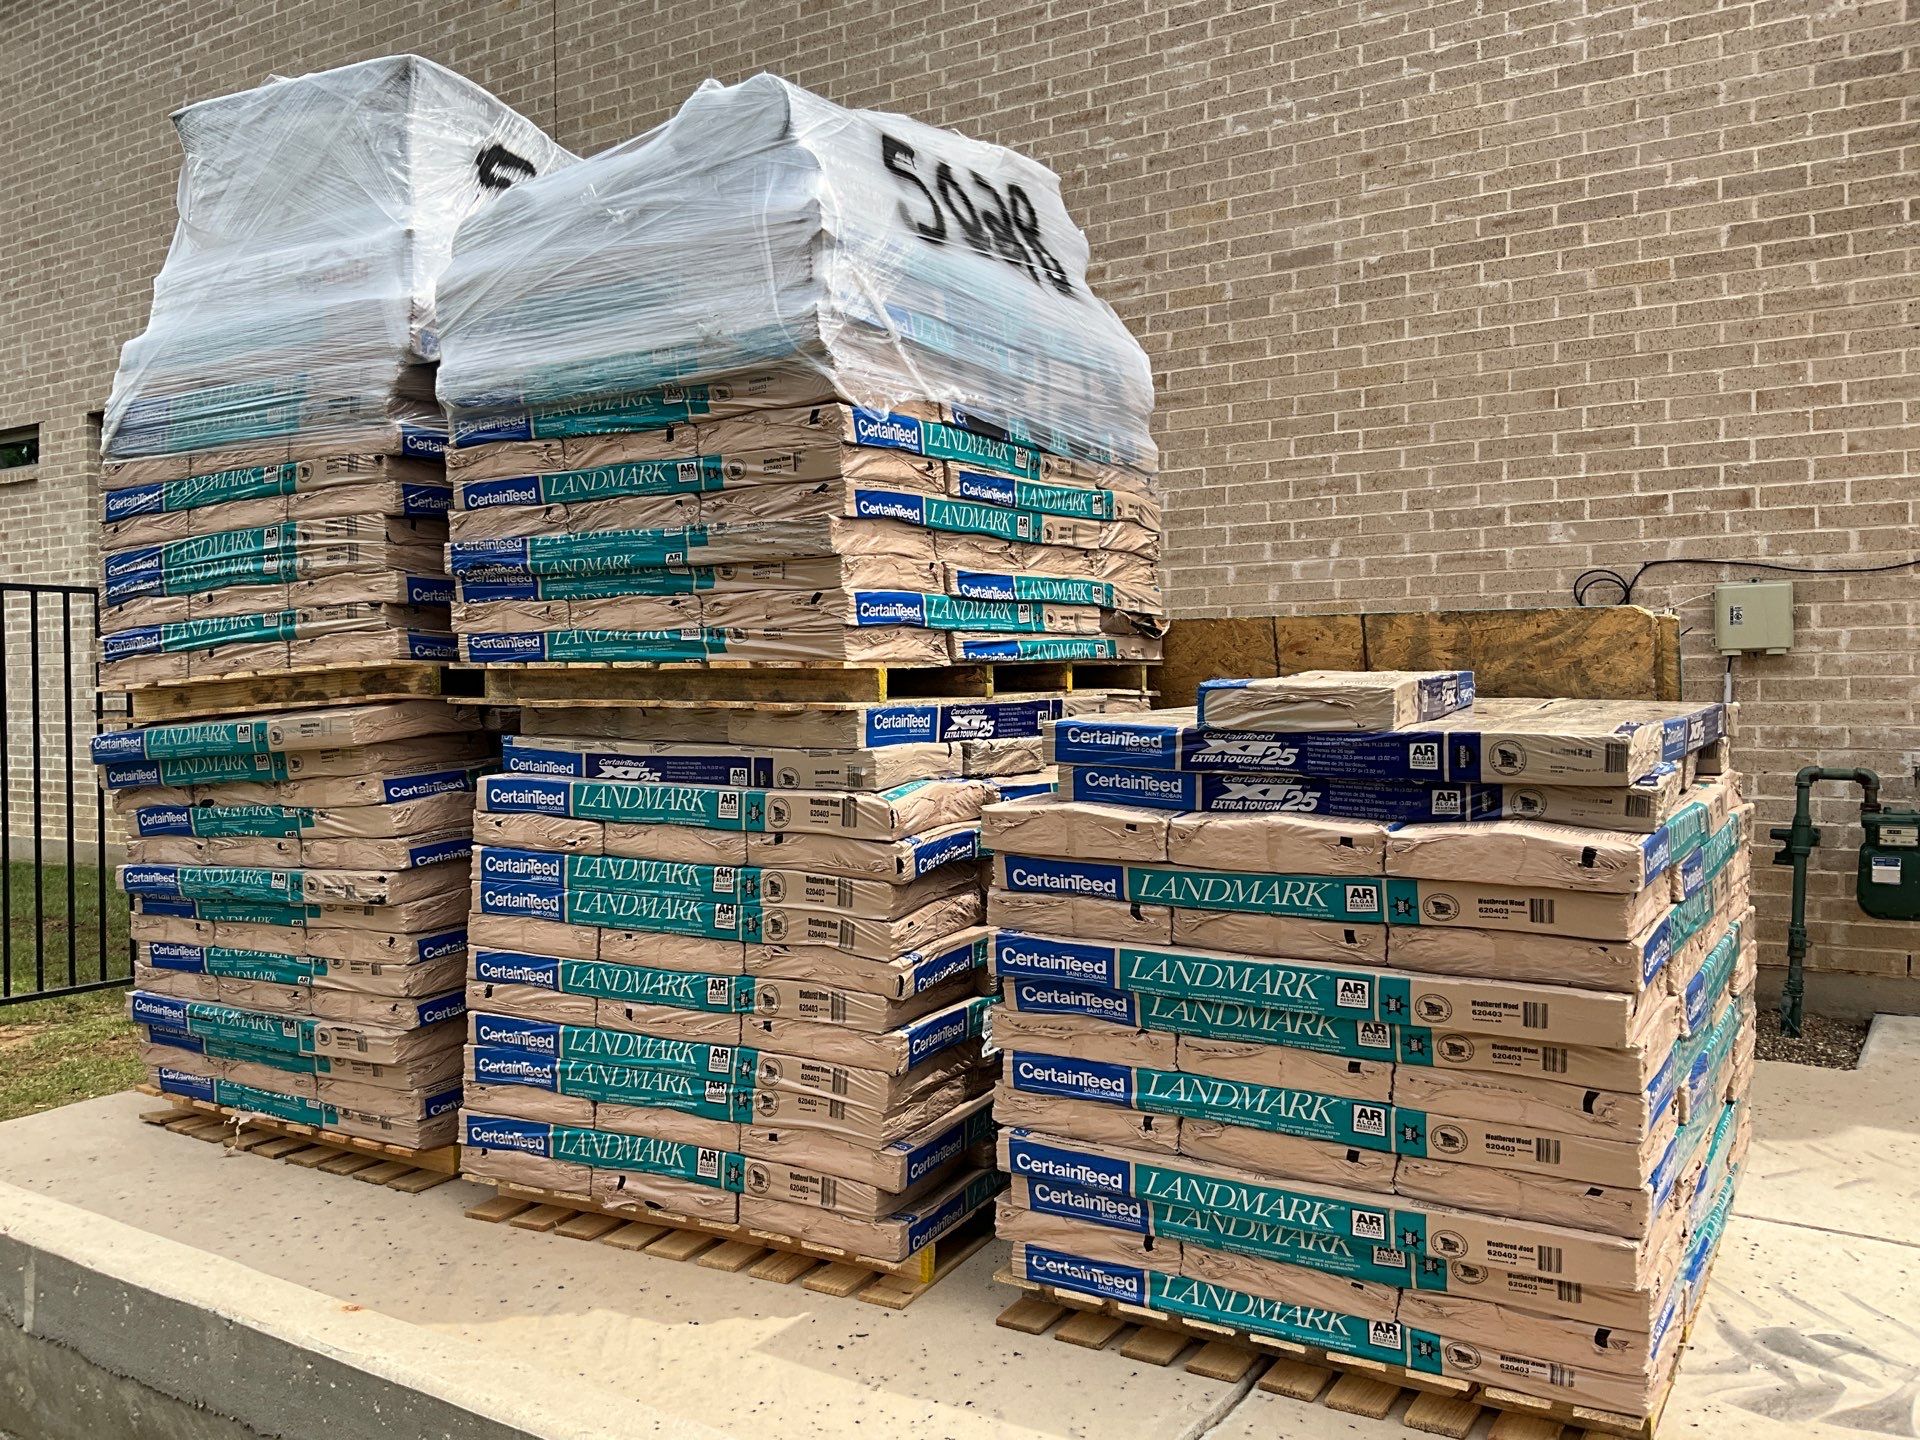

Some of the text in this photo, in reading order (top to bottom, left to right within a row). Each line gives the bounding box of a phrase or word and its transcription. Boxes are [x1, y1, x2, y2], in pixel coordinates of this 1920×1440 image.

[459, 415, 526, 434] CertainTeed
[858, 419, 918, 444] CertainTeed
[928, 423, 1009, 461] LANDMARK
[680, 463, 695, 473] AR
[170, 467, 256, 498] LANDMARK
[550, 462, 668, 496] LANDMARK
[468, 487, 536, 507] CertainTeed
[962, 482, 1013, 504] CertainTeed
[1021, 486, 1089, 511] LANDMARK
[860, 501, 920, 521] CertainTeed
[930, 503, 1013, 532] LANDMARK
[168, 528, 257, 563] LANDMARK
[539, 554, 634, 575] LANDMARK
[962, 584, 1013, 600] CertainTeed
[1021, 581, 1090, 601] LANDMARK
[860, 602, 921, 618] CertainTeed
[931, 600, 1013, 621] LANDMARK
[168, 616, 255, 641] LANDMARK
[106, 634, 159, 653] CertainTeed
[471, 636, 540, 648] CertainTeed
[951, 708, 985, 716] CertainTeed
[238, 725, 249, 733] AR
[874, 714, 930, 729] CertainTeed
[977, 720, 995, 737] 25
[94, 736, 141, 750] CertainTeed
[151, 724, 231, 746] LANDMARK
[1067, 727, 1163, 749] CertainTeed
[1203, 732, 1275, 741] CertainTeed
[1260, 748, 1299, 766] 25
[1413, 745, 1435, 755] AR
[167, 756, 248, 777] LANDMARK
[510, 758, 574, 775] CertainTeed
[599, 758, 645, 767] CertainTeed
[1190, 754, 1261, 764] EXTRA TOUGH
[109, 768, 157, 783] CertainTeed
[732, 769, 746, 777] AR
[1222, 775, 1294, 784] CertainTeed
[390, 780, 464, 798] CertainTeed
[1085, 772, 1182, 793] CertainTeed
[490, 789, 564, 806] CertainTeed
[578, 785, 706, 813] LANDMARK
[721, 794, 737, 804] AR
[1281, 792, 1321, 811] 25
[1436, 792, 1457, 801] AR
[1211, 800, 1281, 811] EXTRA TOUGH
[140, 813, 187, 826] CertainTeed
[810, 810, 829, 818] 620403
[485, 856, 559, 875] CertainTeed
[573, 856, 701, 886] LANDMARK
[716, 867, 732, 877] AR
[126, 872, 174, 884] CertainTeed
[1012, 869, 1116, 893] CertainTeed
[805, 888, 825, 896] 620403
[1137, 874, 1332, 907] LANDMARK
[1350, 888, 1374, 899] AR
[485, 891, 559, 912] CertainTeed
[573, 891, 702, 922] LANDMARK
[1478, 898, 1508, 906] Weathered
[718, 905, 734, 915] AR
[808, 930, 827, 939] 620403
[152, 944, 200, 956] CertainTeed
[1001, 947, 1107, 975] CertainTeed
[480, 962, 553, 984] CertainTeed
[917, 956, 970, 992] CertainTeed
[1066, 970, 1107, 981] SAINT-GOBAIN
[1128, 955, 1325, 1000] LANDMARK
[568, 965, 697, 998] LANDMARK
[710, 980, 726, 990] AR
[1341, 982, 1366, 995] AR
[1021, 986, 1127, 1012] CertainTeed
[1471, 1000, 1501, 1009] Weathered
[135, 1000, 184, 1018] CertainTeed
[799, 1004, 818, 1013] 620403
[1086, 1007, 1127, 1018] SAINT-GOBAIN
[1472, 1010, 1502, 1018] 620403
[1149, 996, 1340, 1038] LANDMARK
[1361, 1022, 1386, 1034] AR
[480, 1026, 554, 1048] CertainTeed
[912, 1019, 965, 1055] CertainTeed
[569, 1030, 698, 1064] LANDMARK
[711, 1048, 729, 1058] AR
[1492, 1044, 1539, 1054] Weathered Wood
[1492, 1053, 1522, 1061] 620403
[479, 1058, 552, 1079] CertainTeed
[566, 1059, 693, 1096] LANDMARK
[708, 1081, 725, 1090] AR
[801, 1073, 820, 1082] 620403
[1019, 1063, 1125, 1092] CertainTeed
[1084, 1087, 1124, 1098] SAINT-GOBAIN
[1146, 1073, 1341, 1124] LANDMARK
[798, 1096, 817, 1106] 620403
[1356, 1108, 1382, 1121] AR
[472, 1127, 545, 1150] CertainTeed
[1485, 1134, 1532, 1145] Weathered Wood
[559, 1130, 687, 1168] LANDMARK
[1485, 1143, 1516, 1152] 620403
[700, 1151, 717, 1161] AR
[910, 1136, 962, 1179] CertainTeed
[1016, 1153, 1122, 1189] CertainTeed
[790, 1184, 809, 1193] 620403
[1035, 1184, 1141, 1218] CertainTeed
[1143, 1172, 1339, 1228] LANDMARK
[1101, 1212, 1140, 1225] SAINT-GOBAIN
[1356, 1214, 1382, 1226] AR
[912, 1205, 963, 1250] CertainTeed
[1164, 1205, 1354, 1257] LANDMARK
[1487, 1240, 1534, 1253] Weathered Wood
[1487, 1250, 1518, 1259] 620403
[1376, 1251, 1402, 1259] ALGAE
[1032, 1255, 1137, 1292] CertainTeed
[1507, 1272, 1554, 1285] Weathered Wood
[1097, 1284, 1137, 1299] SAINT-GOBAIN
[1508, 1281, 1538, 1290] 620403
[1159, 1275, 1351, 1335] LANDMARK
[1373, 1322, 1398, 1335] AR
[1372, 1333, 1398, 1341] ALGAE
[1500, 1354, 1546, 1368] Weathered Wood
[1500, 1363, 1530, 1374] 620403
